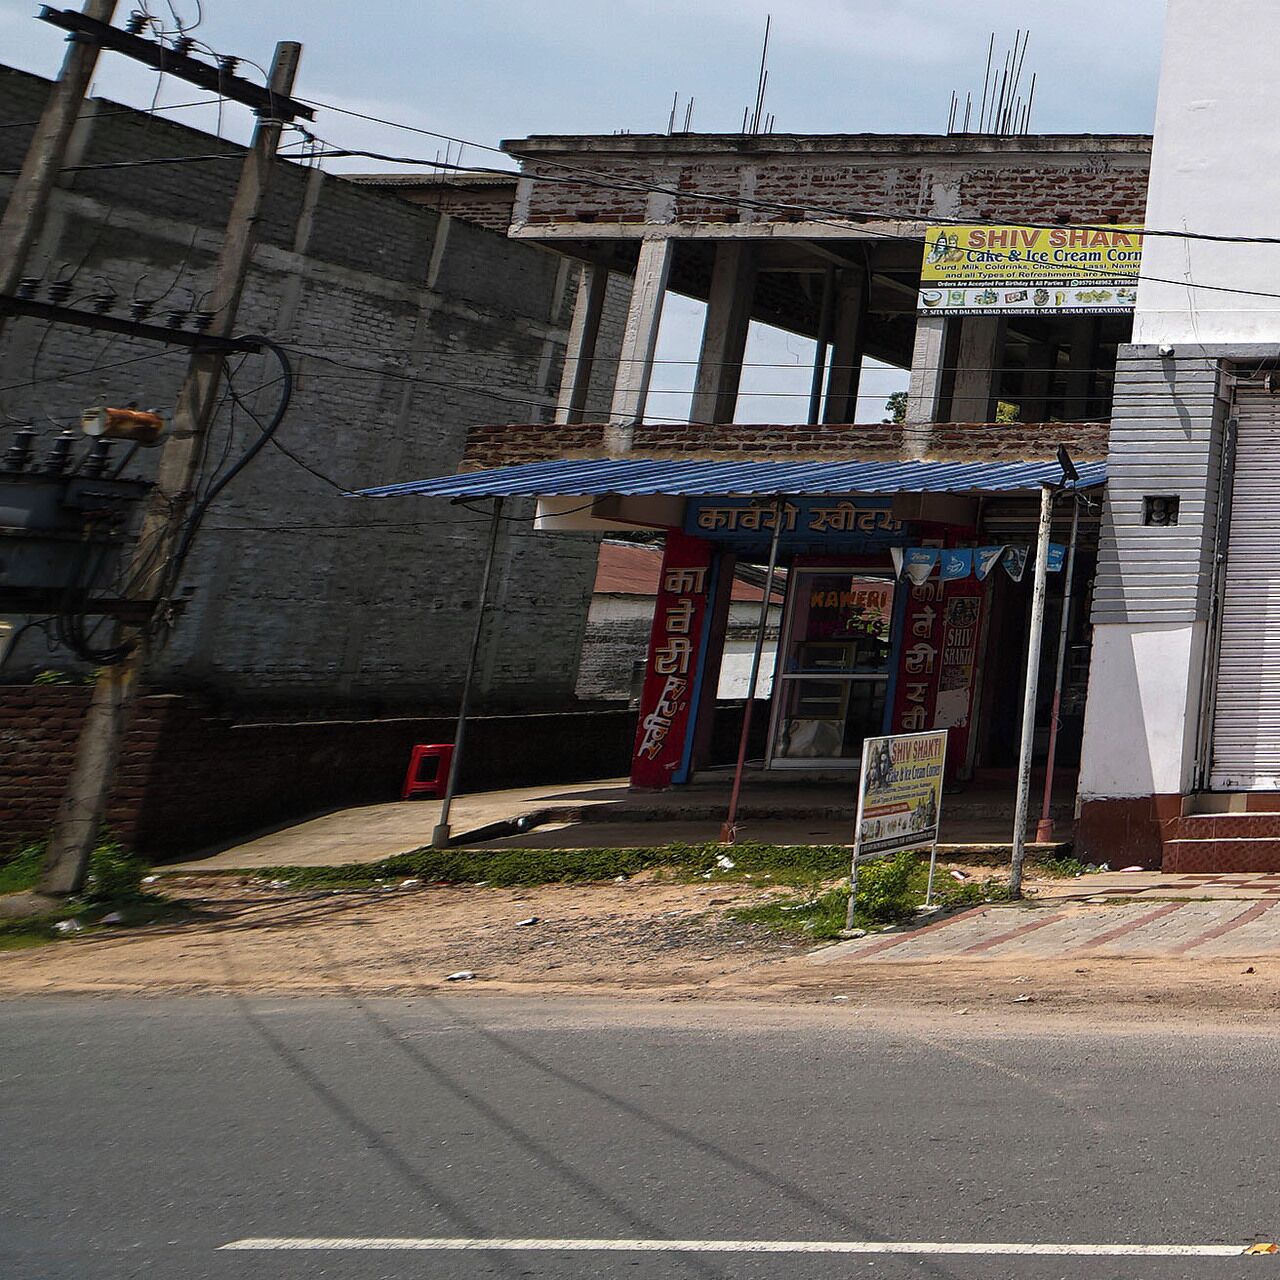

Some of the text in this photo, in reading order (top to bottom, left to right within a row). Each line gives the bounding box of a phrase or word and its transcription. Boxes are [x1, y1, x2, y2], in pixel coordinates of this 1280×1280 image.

[968, 229, 1041, 248] SHIV
[967, 250, 1002, 262] Cake
[1008, 250, 1021, 261] &
[1027, 250, 1048, 261] Ice
[1054, 249, 1100, 261] Cream
[948, 628, 973, 646] SHIV
[891, 741, 911, 764] SHIV
